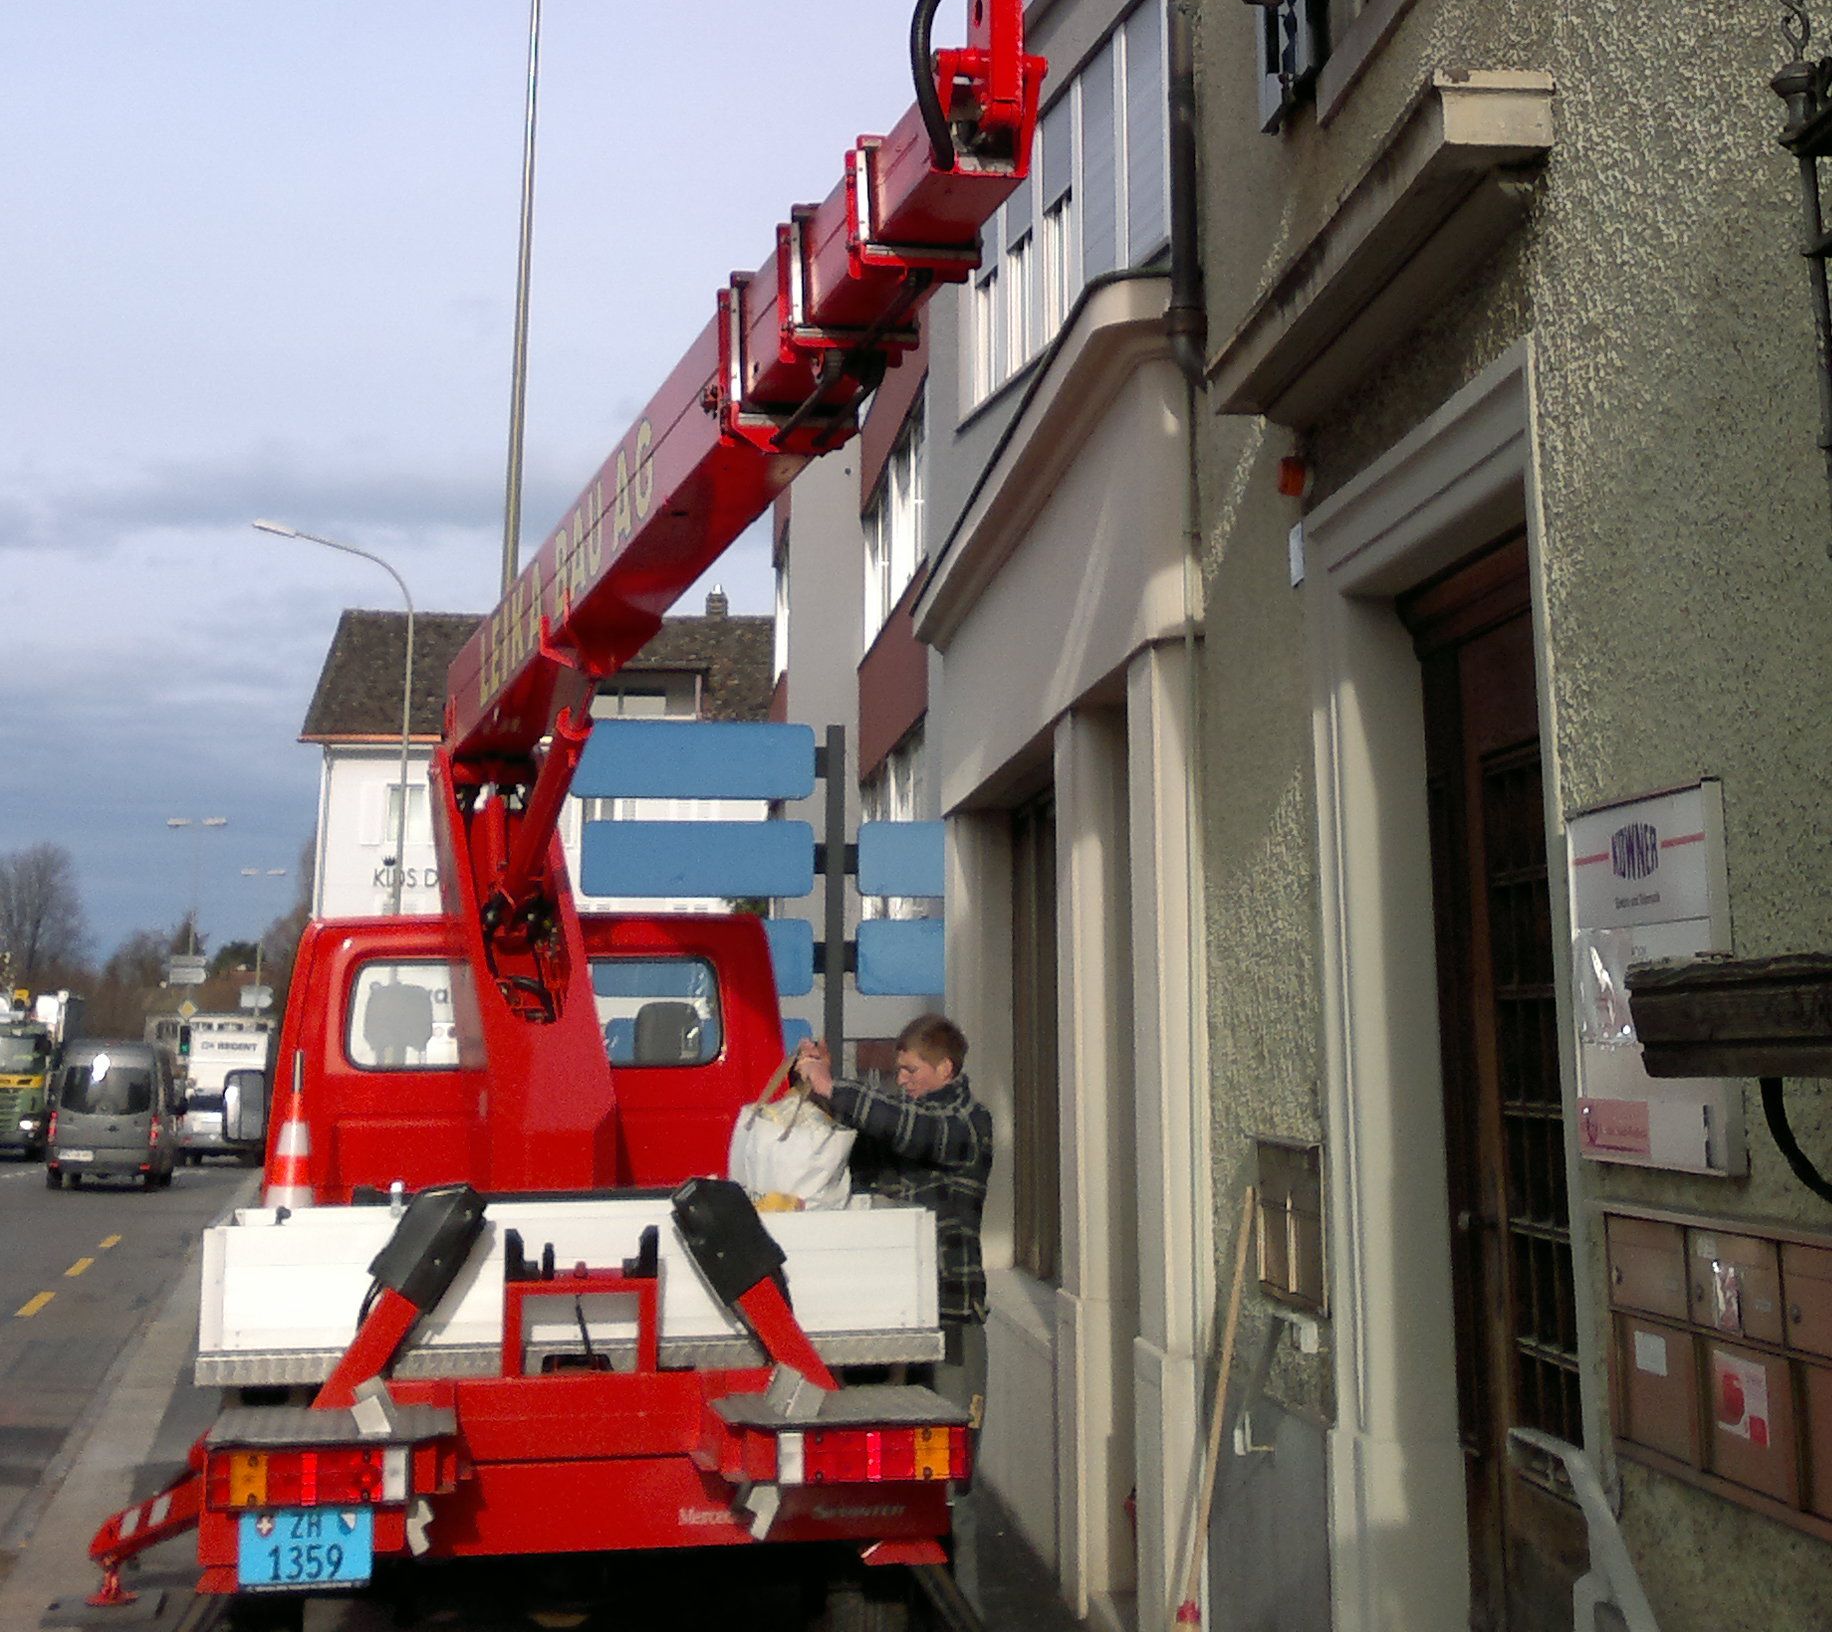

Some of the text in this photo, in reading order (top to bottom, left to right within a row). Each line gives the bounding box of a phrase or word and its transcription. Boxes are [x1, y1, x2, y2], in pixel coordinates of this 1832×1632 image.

[611, 416, 654, 553] AG
[290, 1513, 322, 1539] ZH
[268, 1543, 344, 1581] 1359
